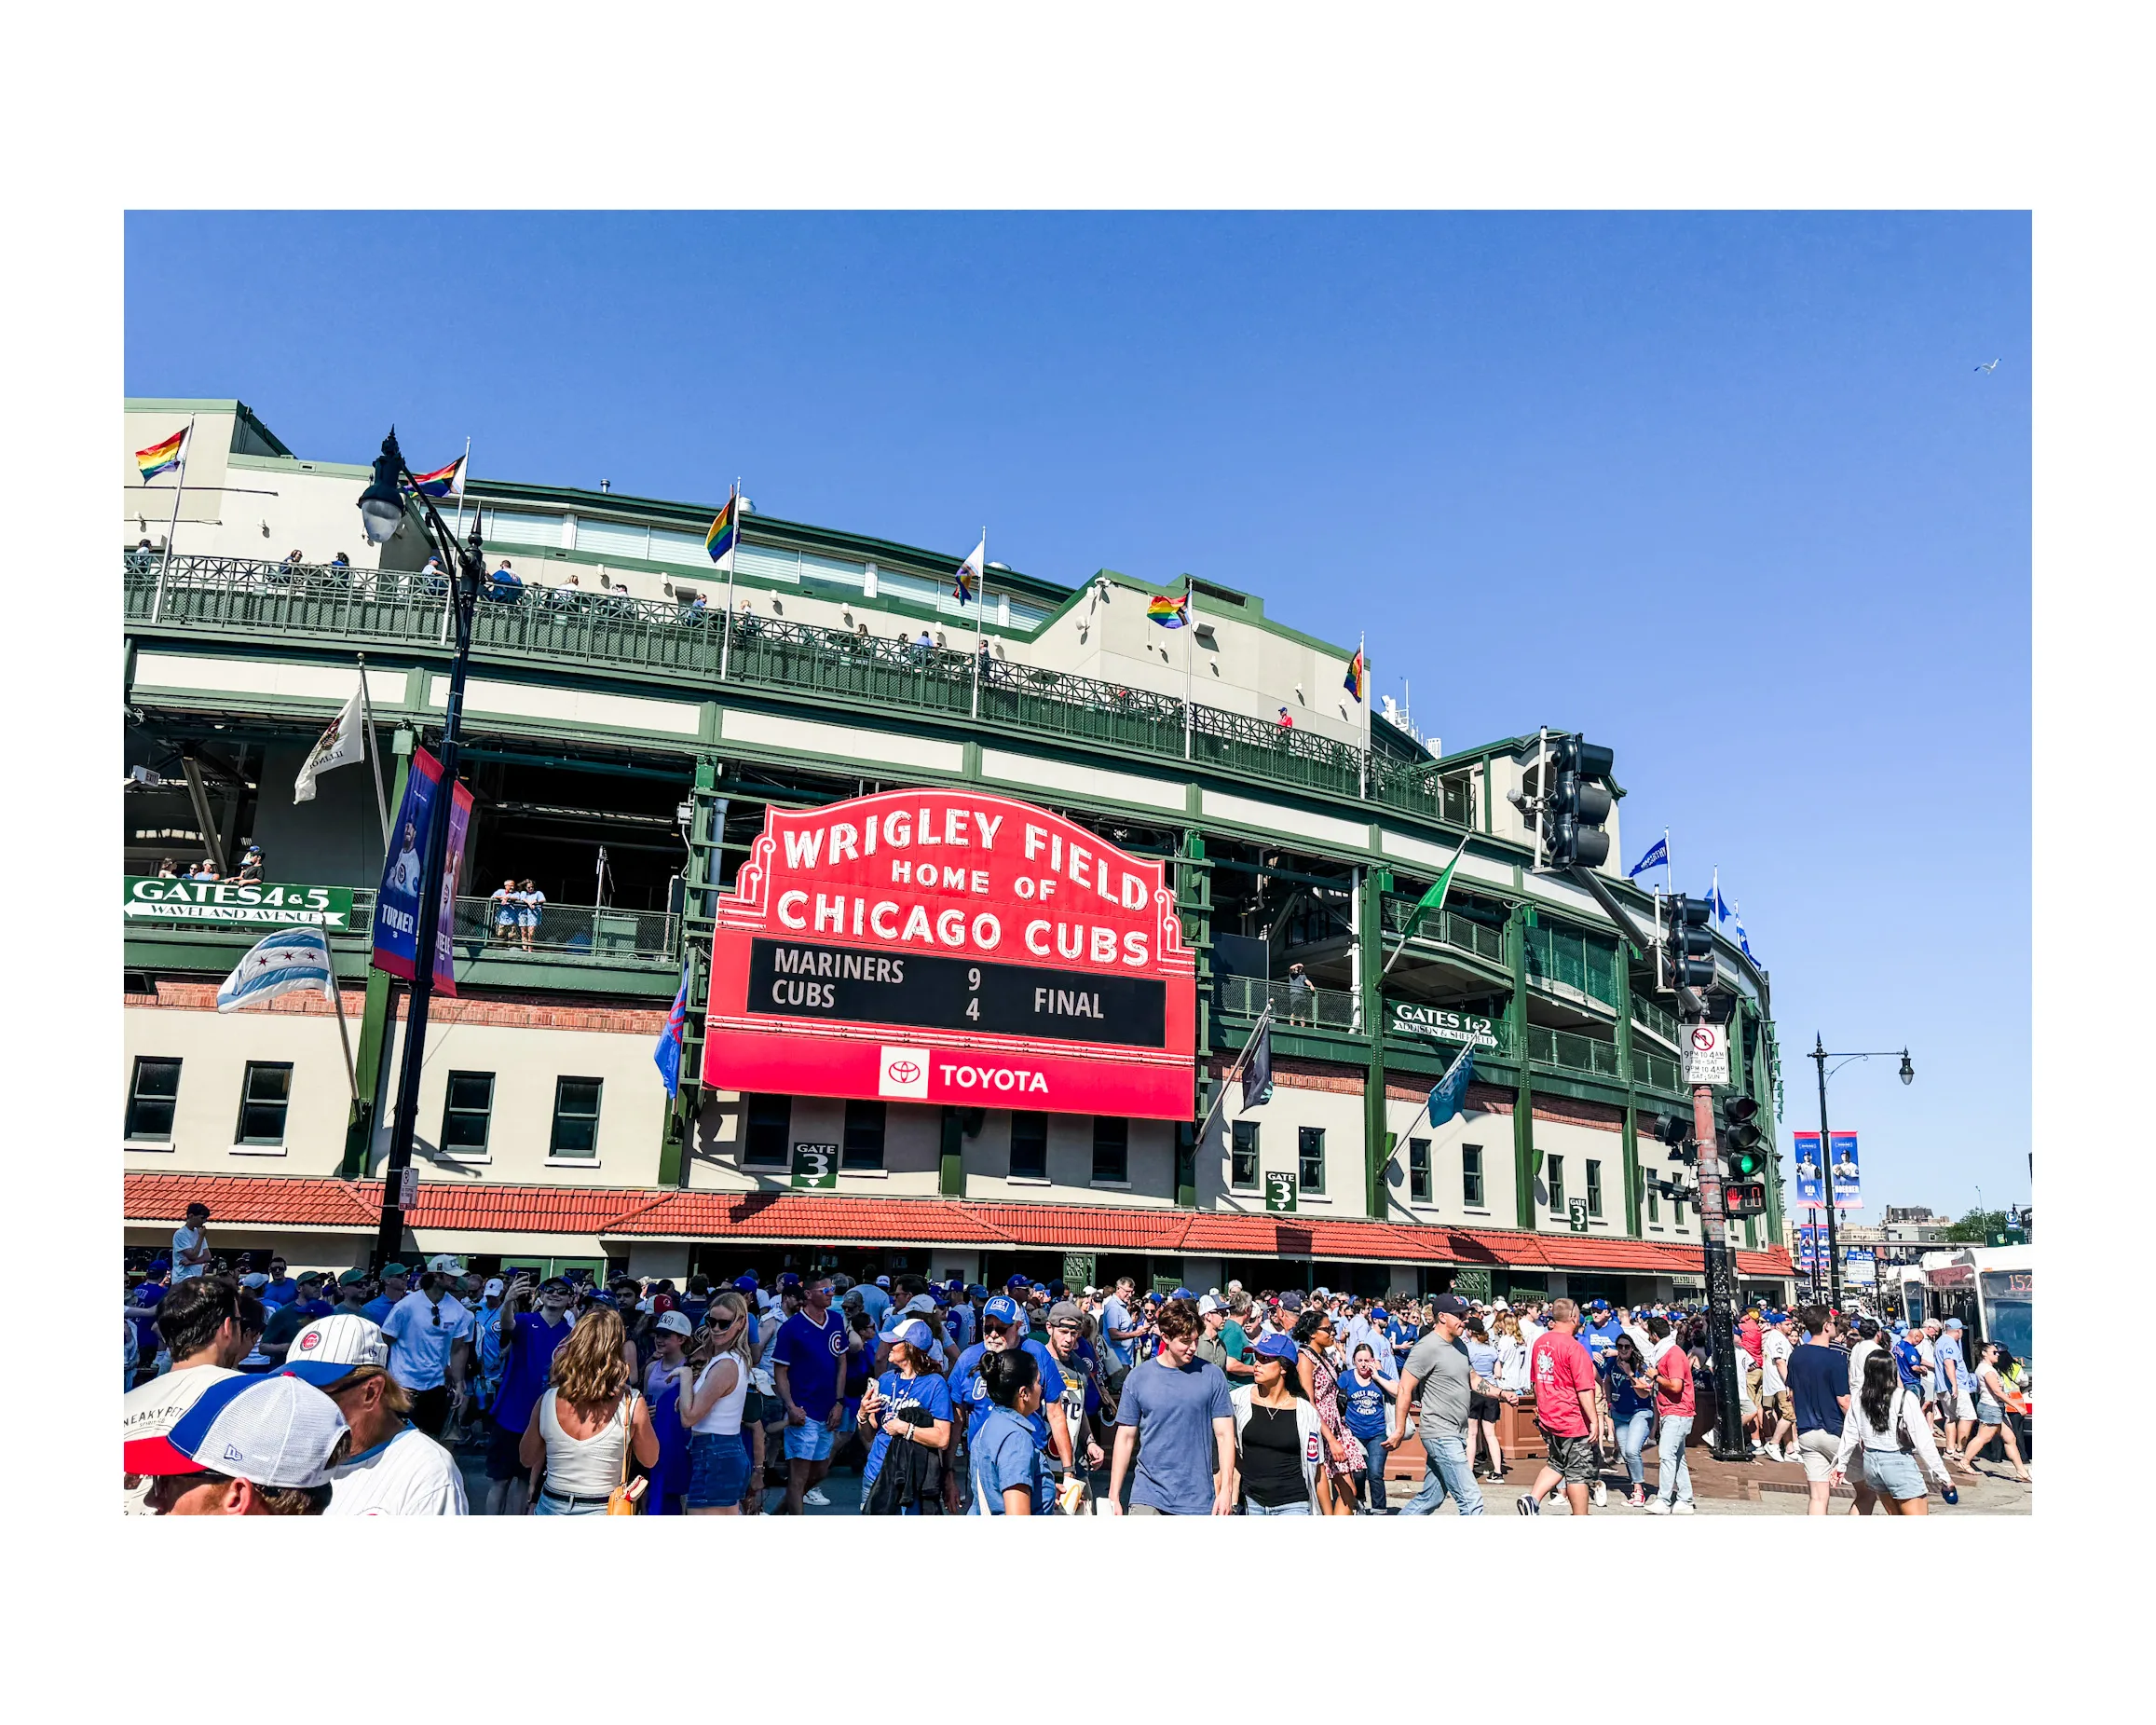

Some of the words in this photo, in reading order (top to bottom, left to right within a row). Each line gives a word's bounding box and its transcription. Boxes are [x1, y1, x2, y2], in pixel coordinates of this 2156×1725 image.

[783, 808, 1003, 869] WRIGLEY
[1025, 822, 1148, 911] FIELD
[892, 859, 989, 895] HOME
[1014, 876, 1058, 901] OF
[132, 881, 262, 906] GATES
[151, 905, 247, 919] WAVELAND
[252, 910, 320, 923] AVENUE
[382, 904, 414, 934] TURNER
[777, 891, 1002, 951] CHICAGO
[1025, 919, 1149, 967] CUBS
[773, 948, 905, 984] MARINERS
[967, 967, 981, 992] 9
[771, 979, 835, 1008] CUBS
[965, 997, 981, 1021] 4
[1034, 987, 1104, 1020] FINAL
[1396, 1005, 1460, 1028] GATES
[1397, 1021, 1439, 1034] ADDISON
[939, 1064, 1049, 1093] TOYOTA
[797, 1143, 836, 1154] GATE
[799, 1154, 829, 1179] 3
[1267, 1172, 1295, 1182] GATE
[1271, 1181, 1292, 1203] 3
[1572, 1205, 1585, 1225] 3
[2009, 1274, 2032, 1291] 152
[1520, 1350, 1526, 1370] 7
